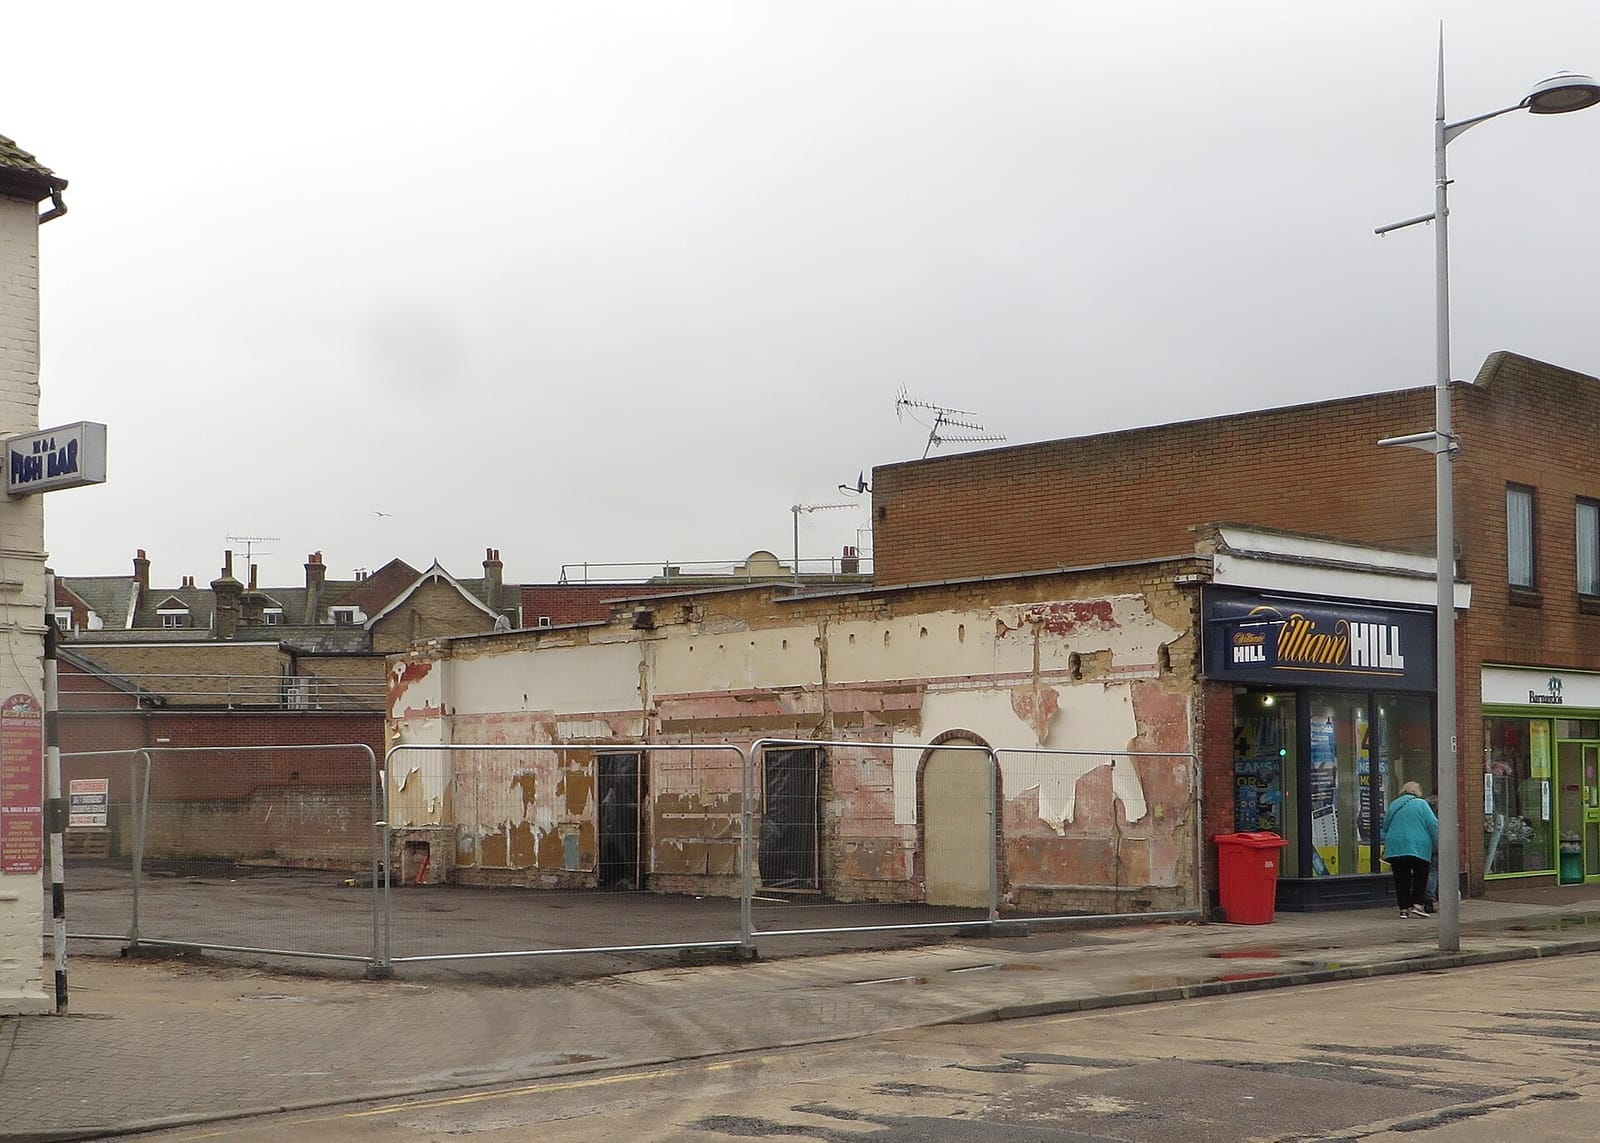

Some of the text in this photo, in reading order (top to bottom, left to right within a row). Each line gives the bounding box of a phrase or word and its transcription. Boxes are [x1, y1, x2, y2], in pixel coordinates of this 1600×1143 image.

[50, 437, 56, 450] A
[11, 438, 79, 485] FISH BAR
[1233, 645, 1266, 663] HILL
[1264, 609, 1405, 669] illiam HILL
